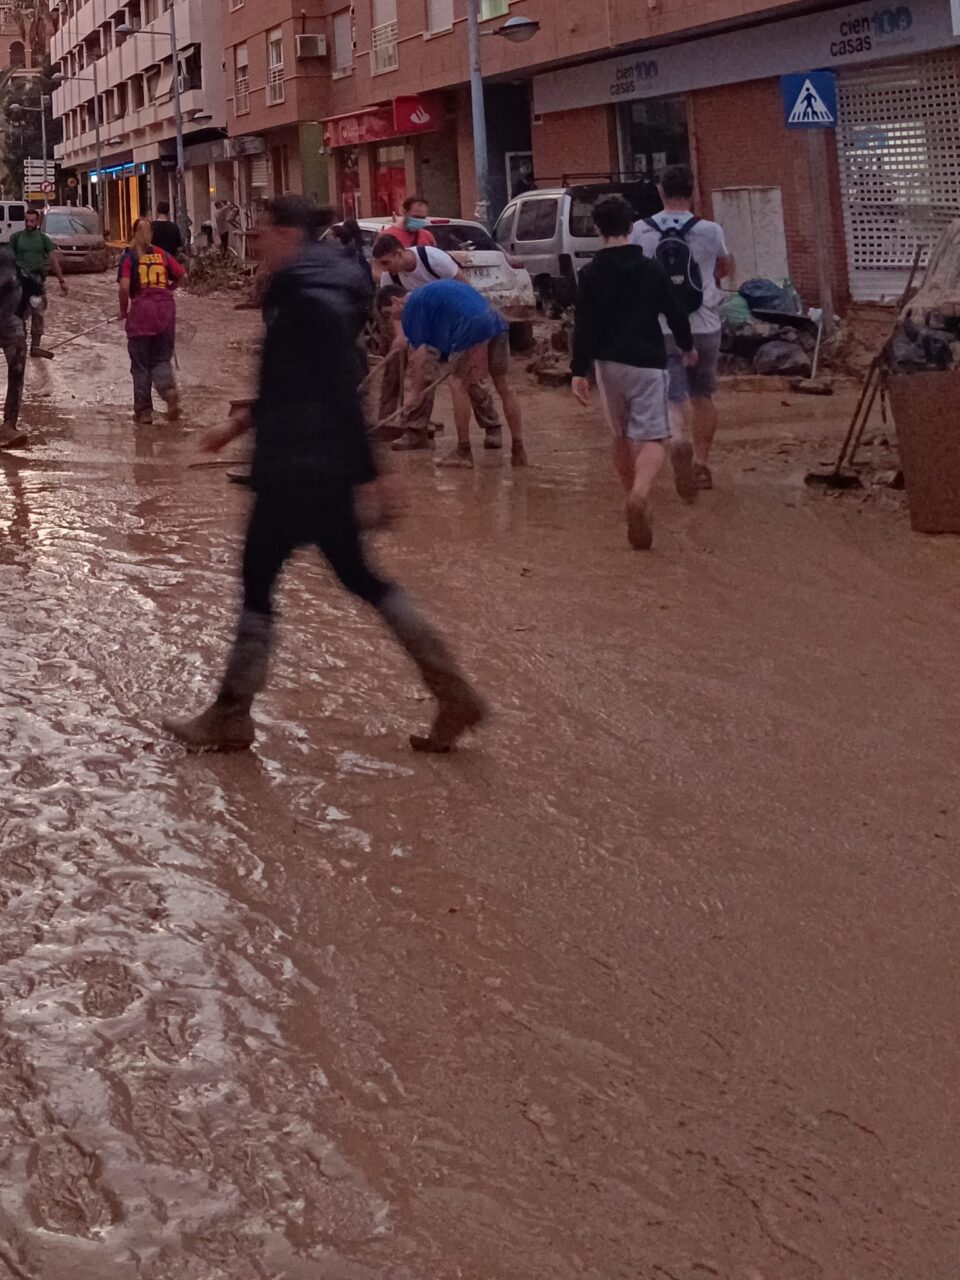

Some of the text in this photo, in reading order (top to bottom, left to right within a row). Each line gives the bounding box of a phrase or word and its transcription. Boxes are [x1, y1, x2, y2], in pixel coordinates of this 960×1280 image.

[840, 14, 871, 36] cien
[830, 36, 872, 57] casas
[610, 81, 636, 96] casas
[138, 264, 167, 288] 10
